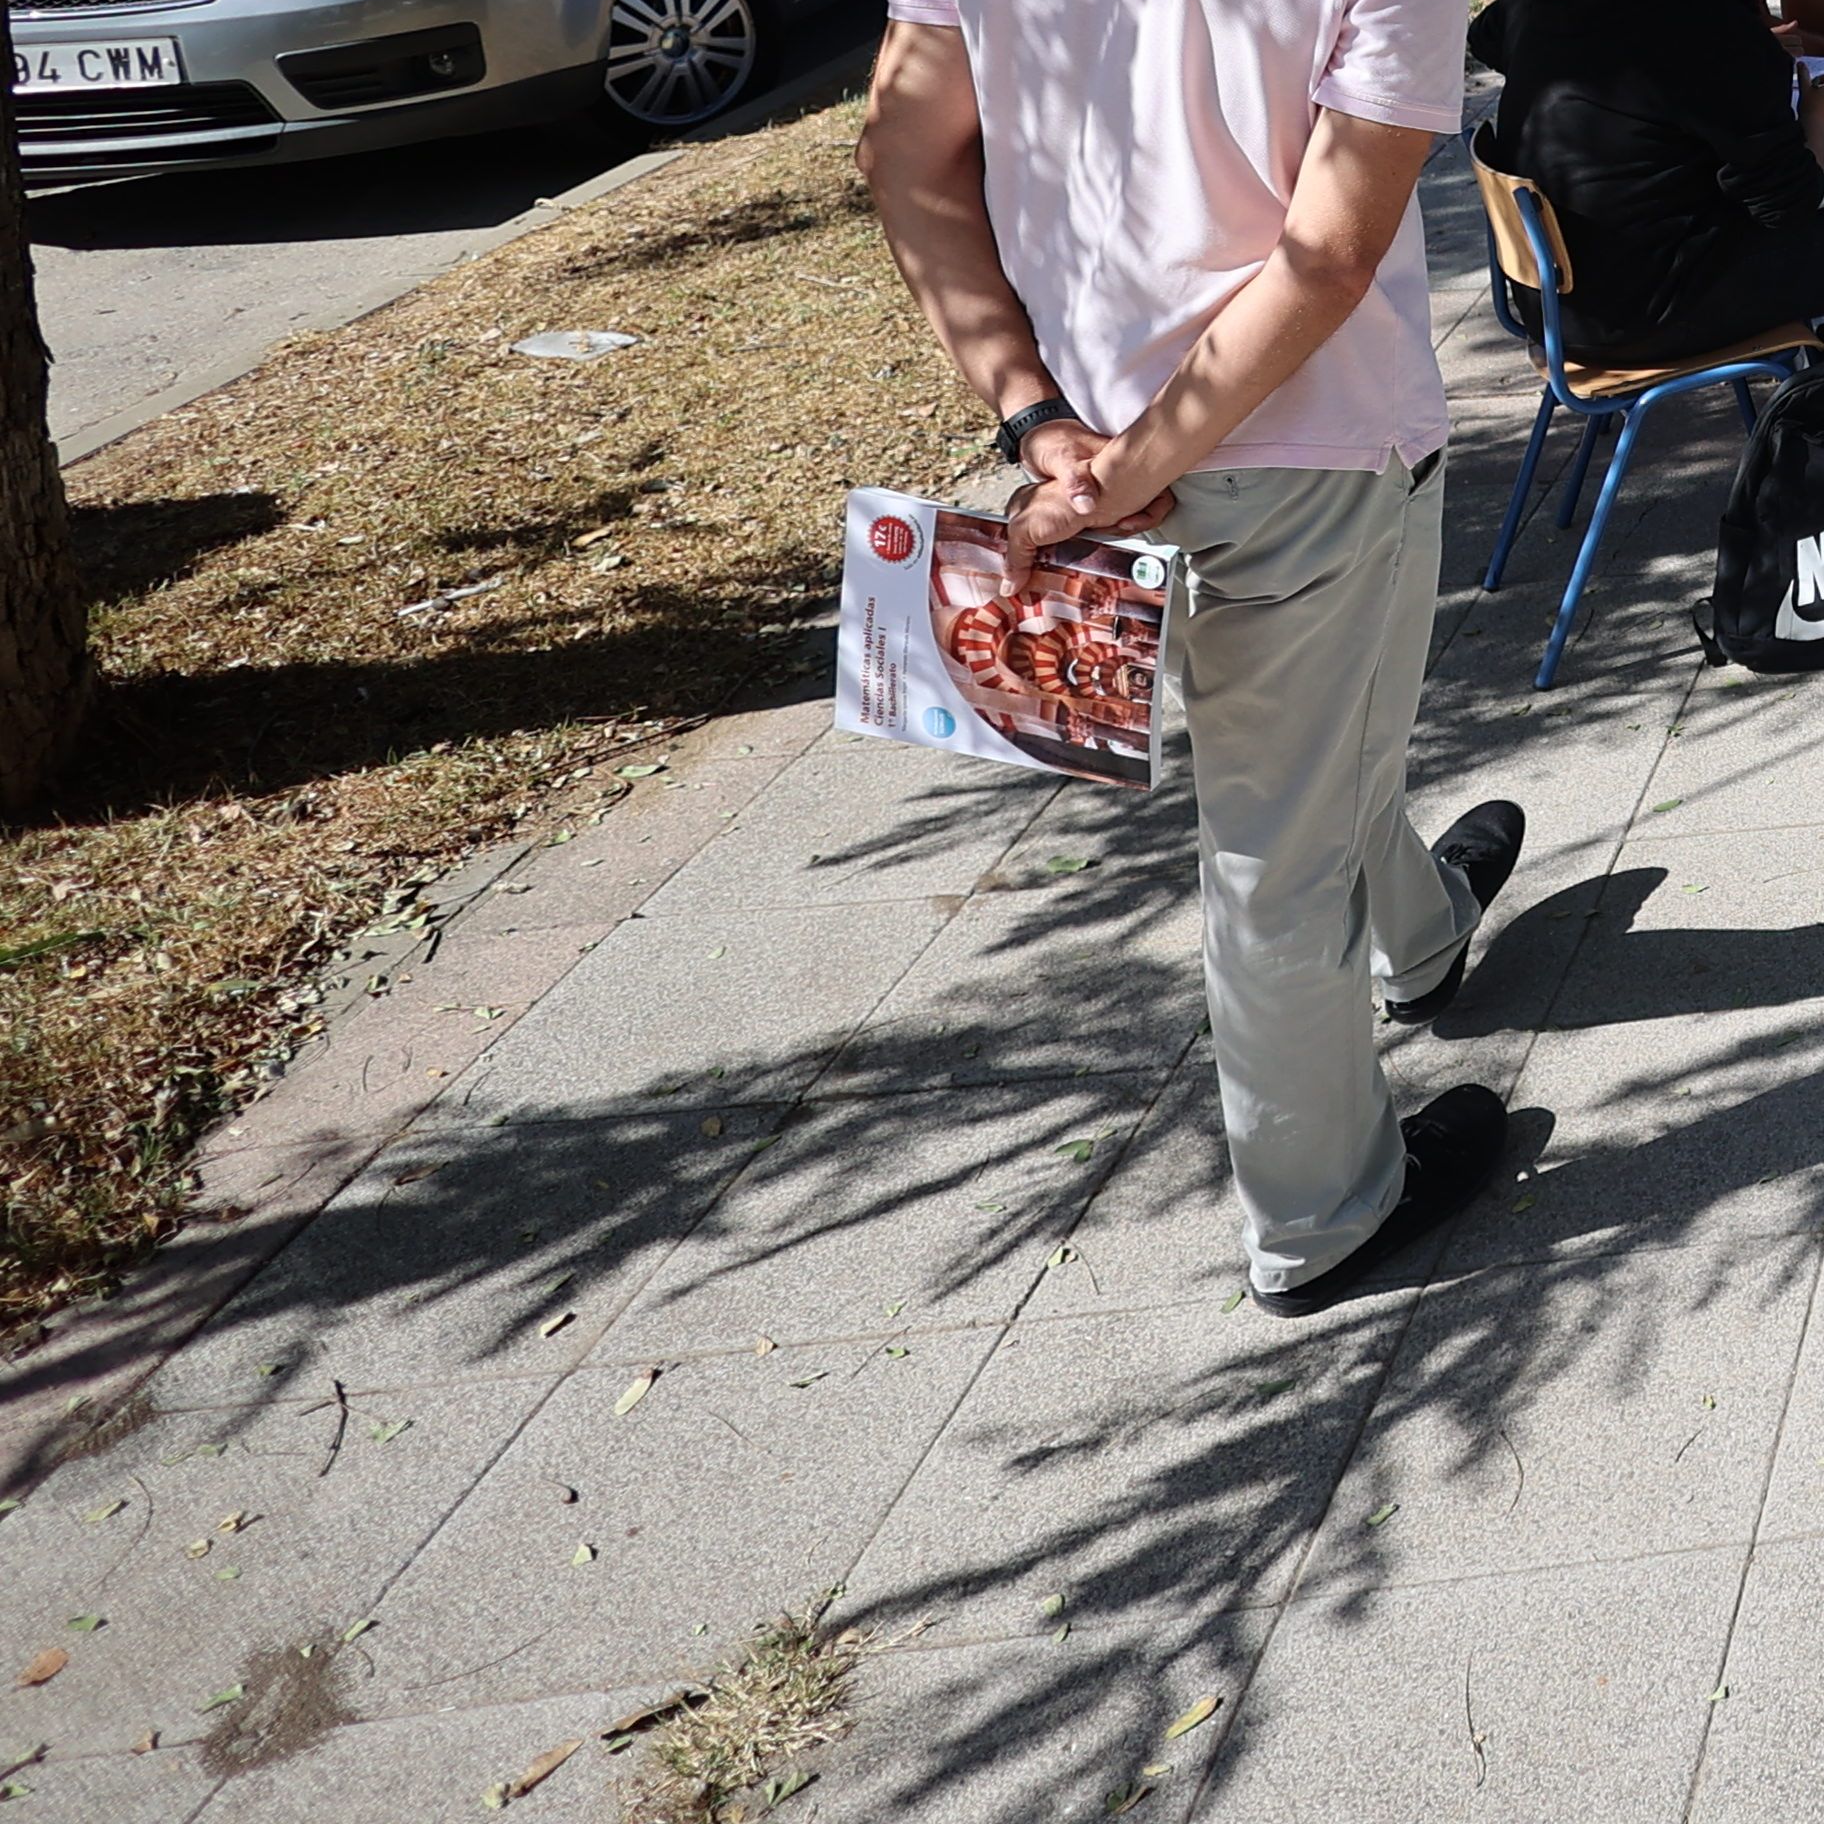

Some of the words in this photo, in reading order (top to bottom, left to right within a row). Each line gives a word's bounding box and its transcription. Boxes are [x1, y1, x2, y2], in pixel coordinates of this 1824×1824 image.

[79, 47, 164, 82] CWM
[863, 596, 876, 650] aplicadas
[876, 634, 887, 683] Sociales
[860, 652, 872, 724] Matemáticas
[874, 687, 885, 726] Ciencias
[888, 663, 897, 716] Bachillerato
